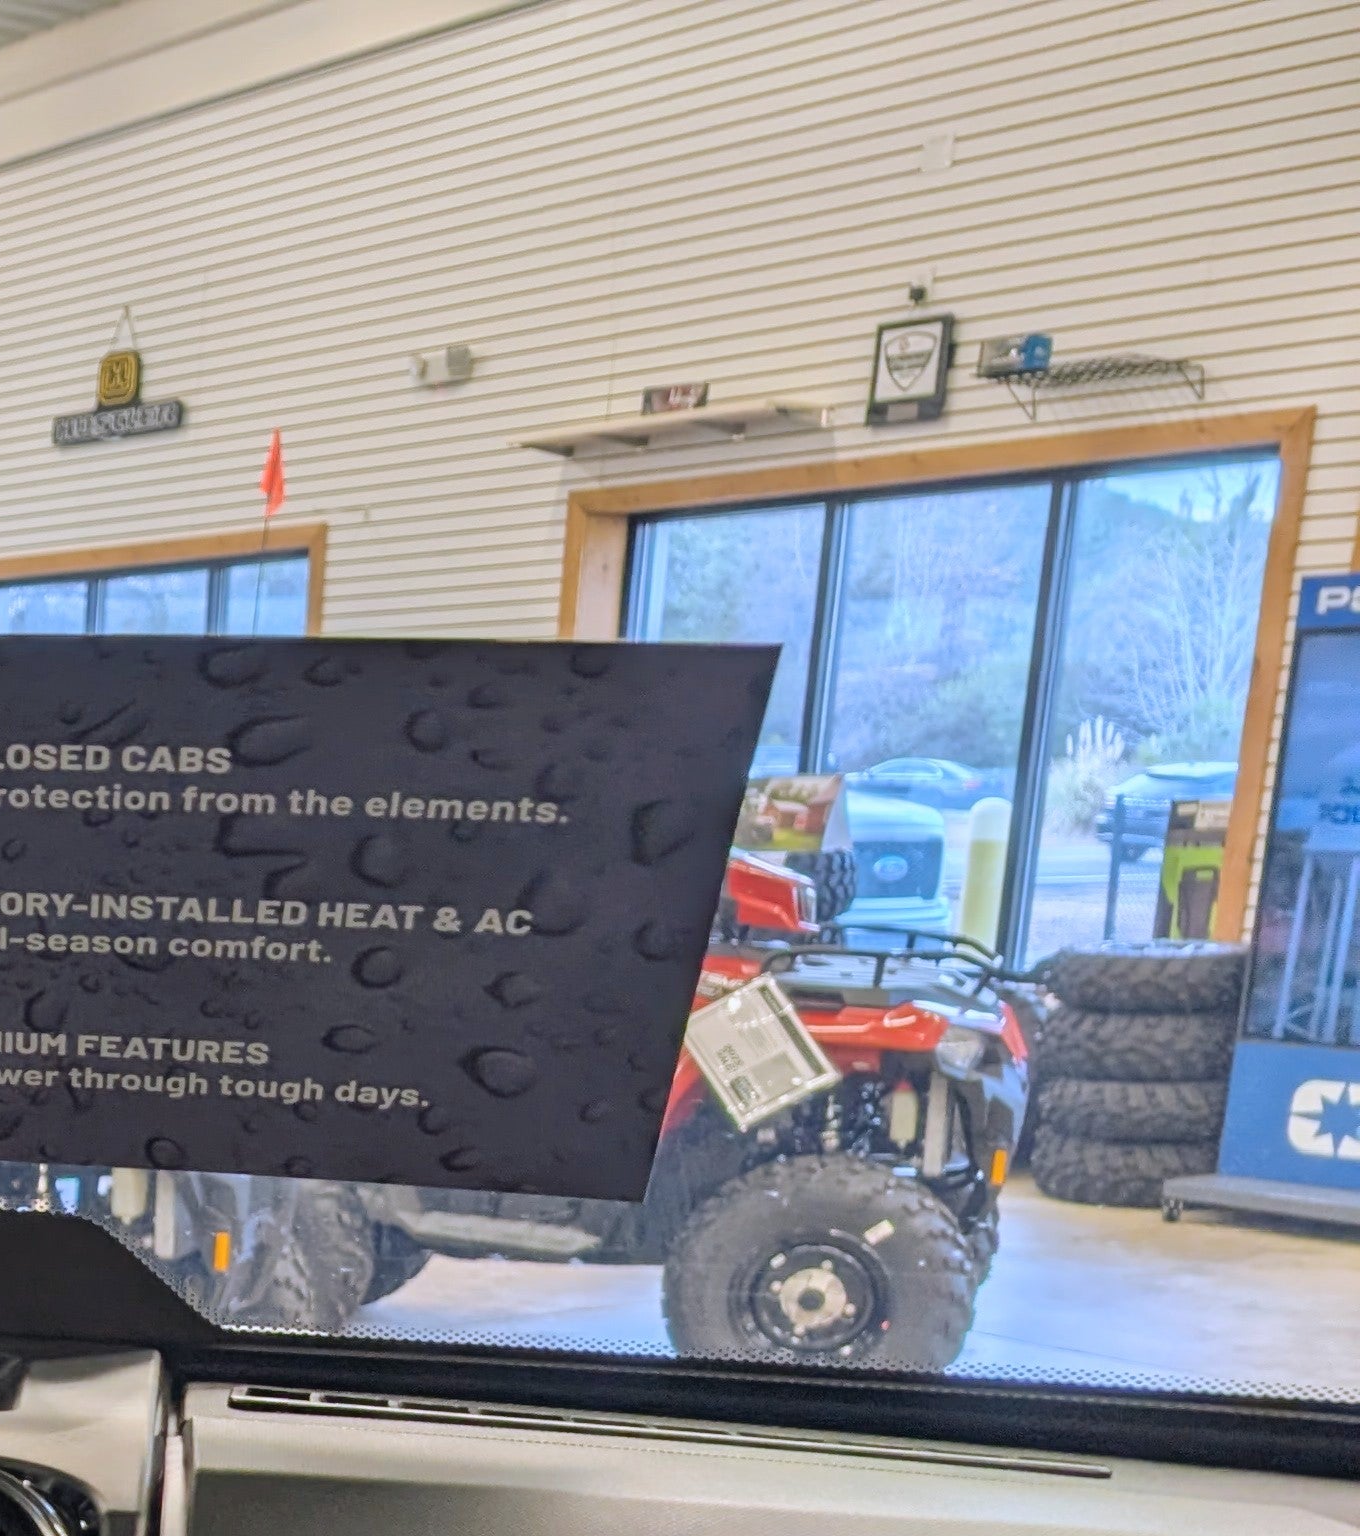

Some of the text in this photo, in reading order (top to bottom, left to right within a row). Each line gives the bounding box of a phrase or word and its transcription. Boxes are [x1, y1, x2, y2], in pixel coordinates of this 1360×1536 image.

[121, 746, 233, 775] CABS
[182, 784, 277, 816] from
[288, 787, 353, 818] the
[363, 791, 571, 827] elements.
[317, 900, 424, 932] HEAT
[432, 905, 464, 932] &
[474, 906, 533, 937] AC
[168, 932, 333, 963] comfort.
[76, 1032, 271, 1066] FEATURES
[67, 1064, 208, 1100] through
[219, 1074, 324, 1105] tough
[333, 1078, 431, 1110] days.
